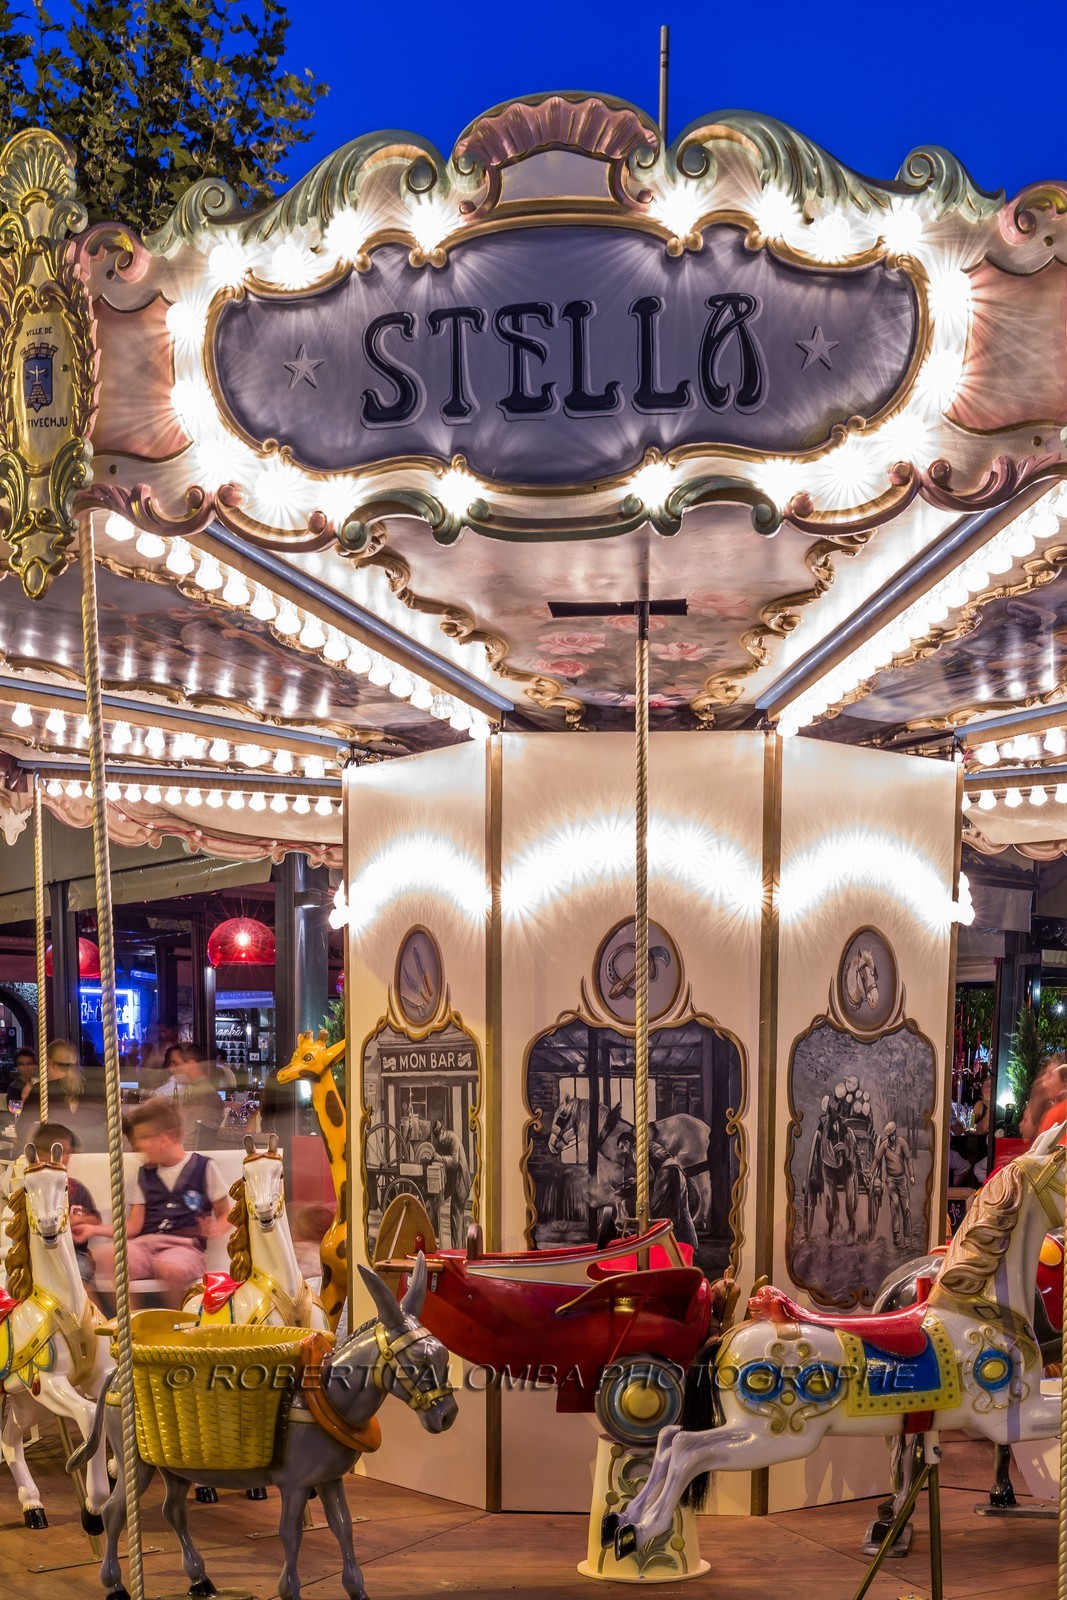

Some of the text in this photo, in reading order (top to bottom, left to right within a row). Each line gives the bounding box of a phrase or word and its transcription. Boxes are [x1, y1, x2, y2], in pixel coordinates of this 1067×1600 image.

[26, 326, 53, 336] VILLE DE
[360, 292, 769, 430] STELLA
[399, 1052, 426, 1070] MON
[430, 1052, 456, 1069] BAR
